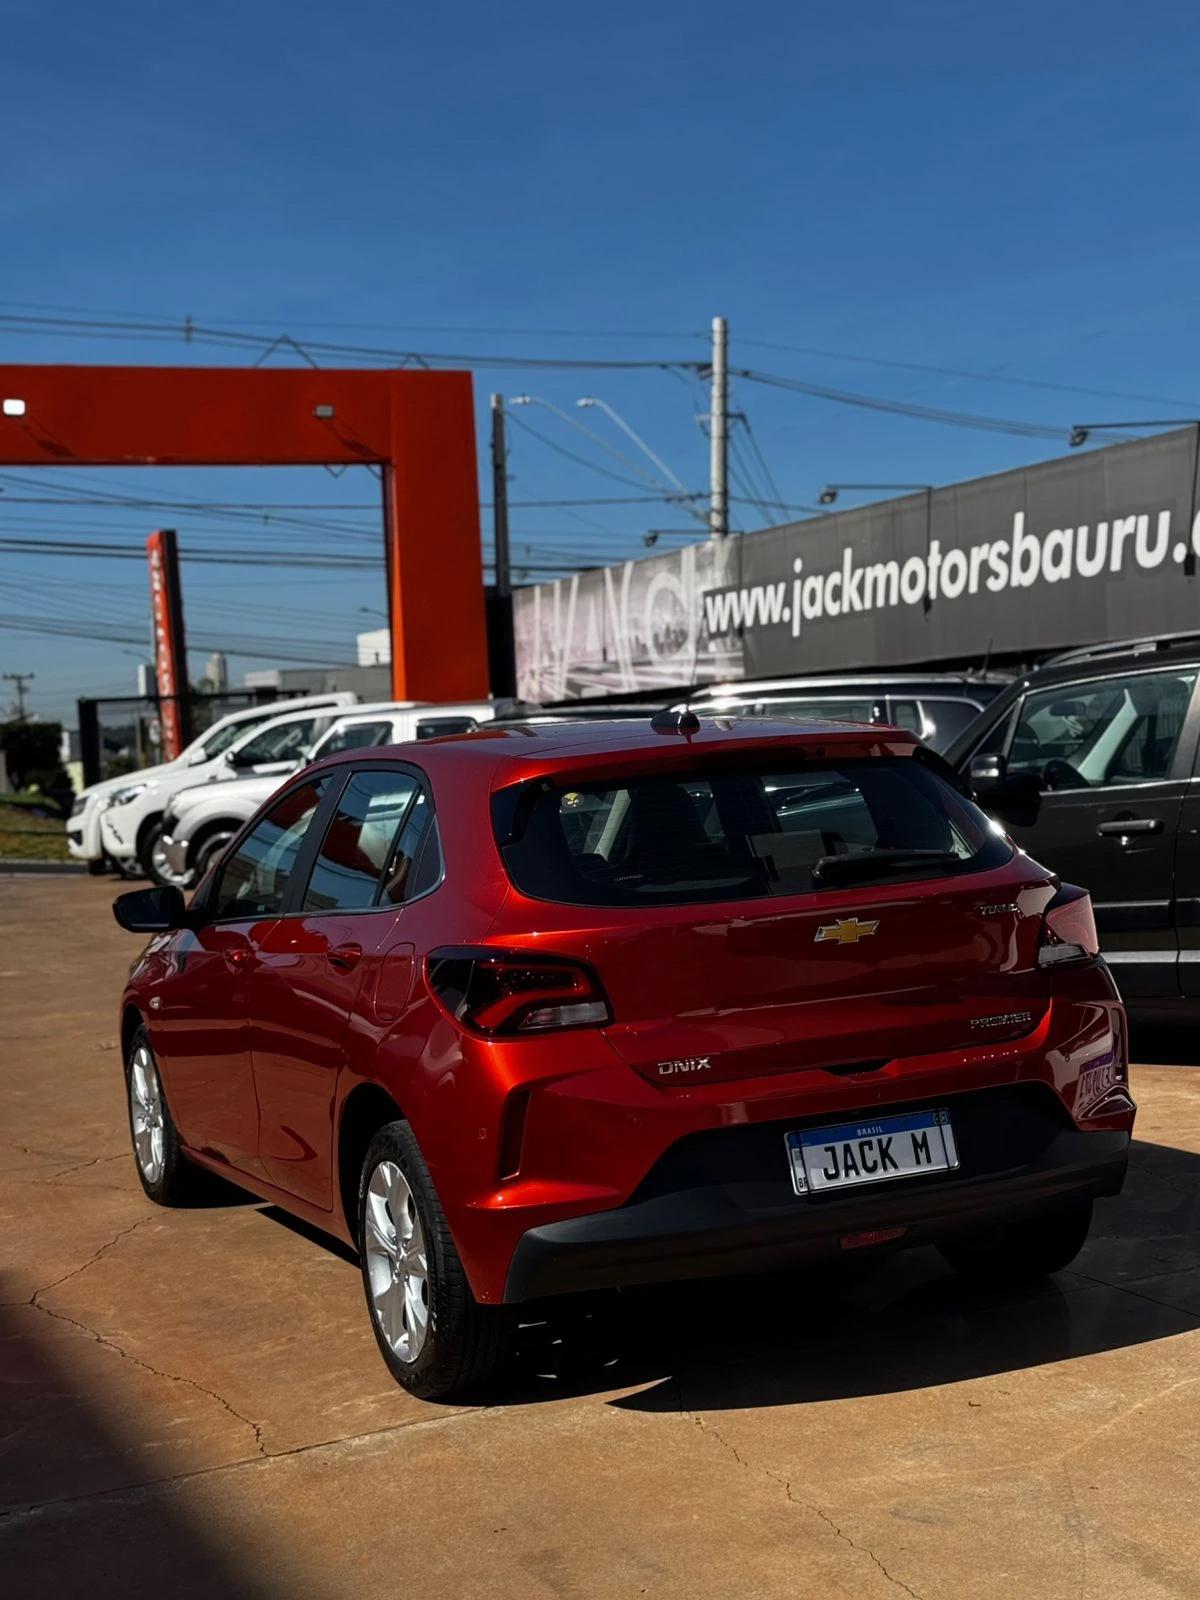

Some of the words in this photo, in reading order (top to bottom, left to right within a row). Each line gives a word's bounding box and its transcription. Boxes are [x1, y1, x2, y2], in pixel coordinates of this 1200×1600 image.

[704, 510, 1200, 637] www.jackmotorsbauru.
[970, 1011, 1031, 1029] PREMIER
[657, 1056, 711, 1075] ONIX
[857, 1125, 884, 1136] BRASIL
[823, 1136, 899, 1180] JACK
[911, 1131, 932, 1165] M
